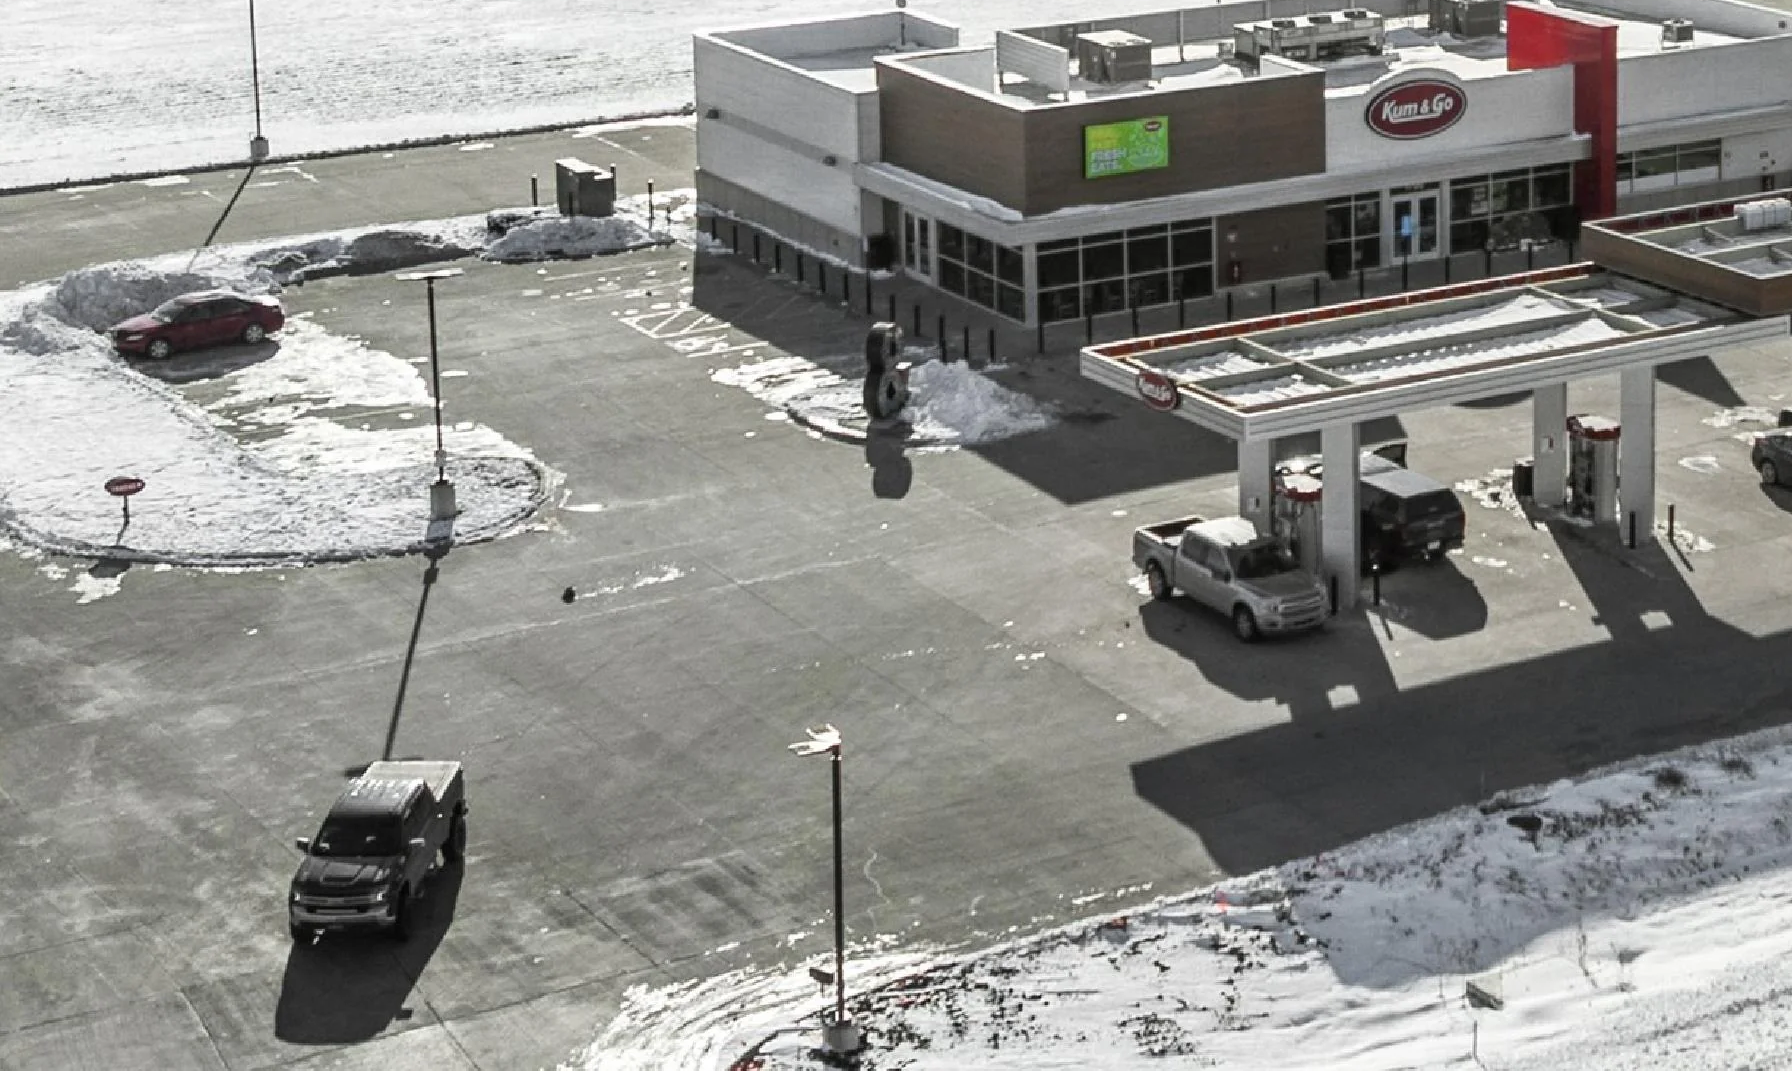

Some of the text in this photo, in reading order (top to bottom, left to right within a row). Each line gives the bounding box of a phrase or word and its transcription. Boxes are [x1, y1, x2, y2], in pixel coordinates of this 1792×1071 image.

[1382, 93, 1454, 123] Kum & Go
